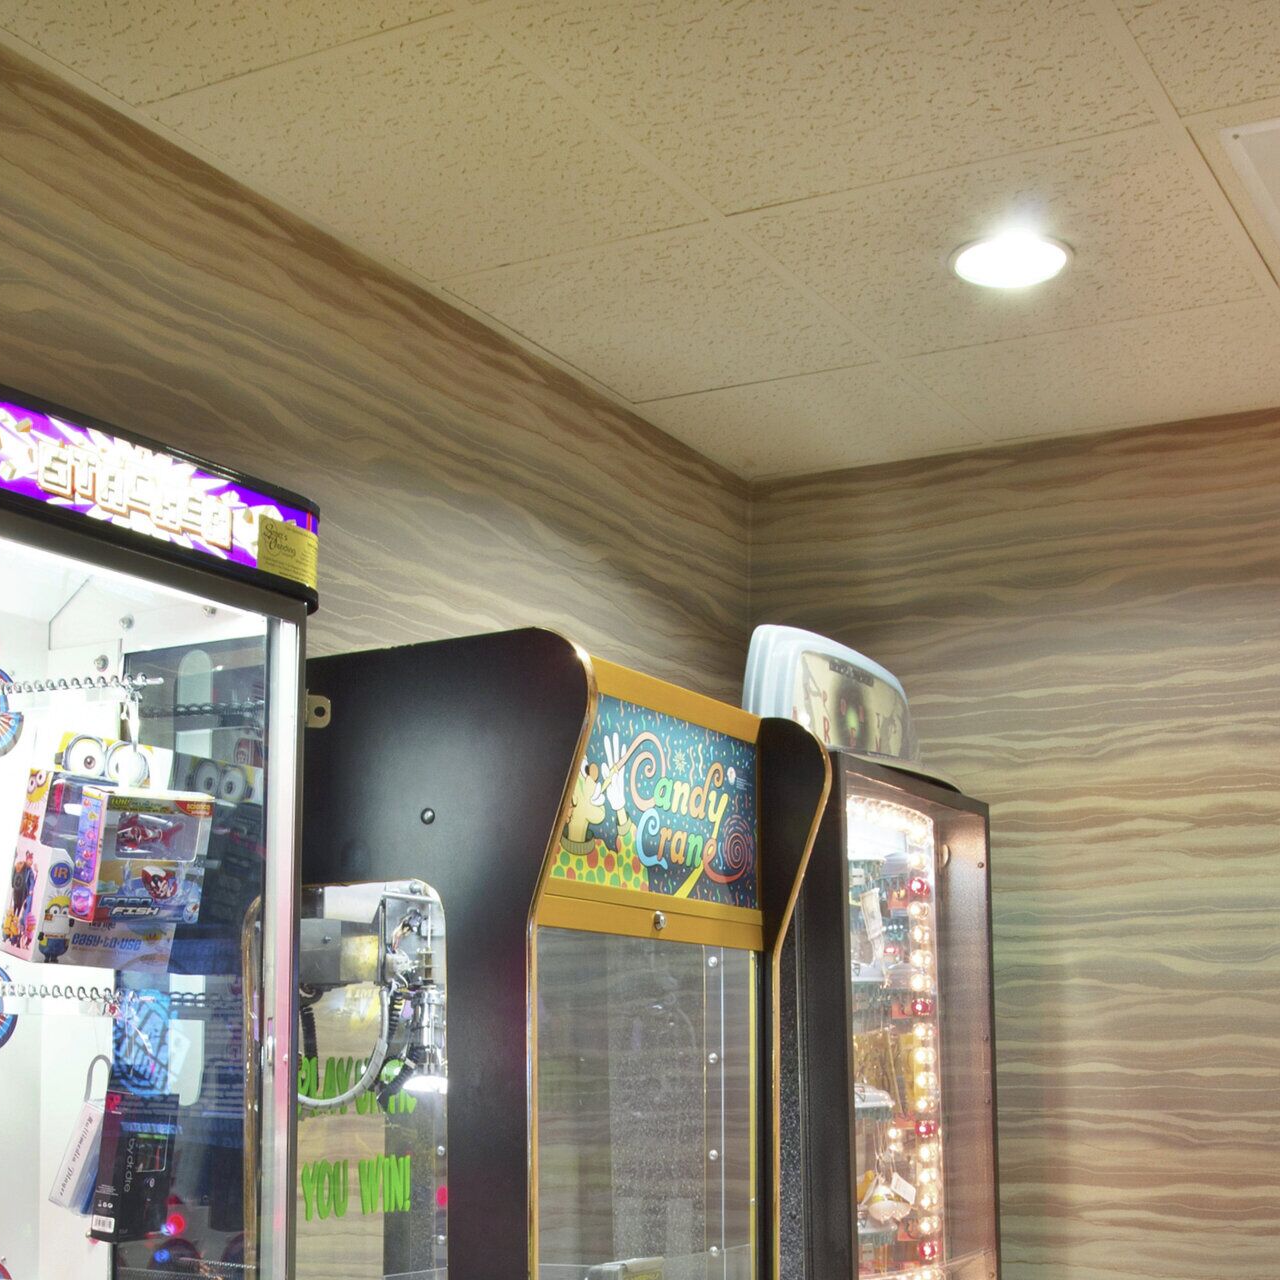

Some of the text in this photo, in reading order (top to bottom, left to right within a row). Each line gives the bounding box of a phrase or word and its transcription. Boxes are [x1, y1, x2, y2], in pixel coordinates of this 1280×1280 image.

[630, 731, 729, 838] Candy
[636, 808, 748, 884] Crane
[301, 1153, 411, 1222] YOU WIN!
